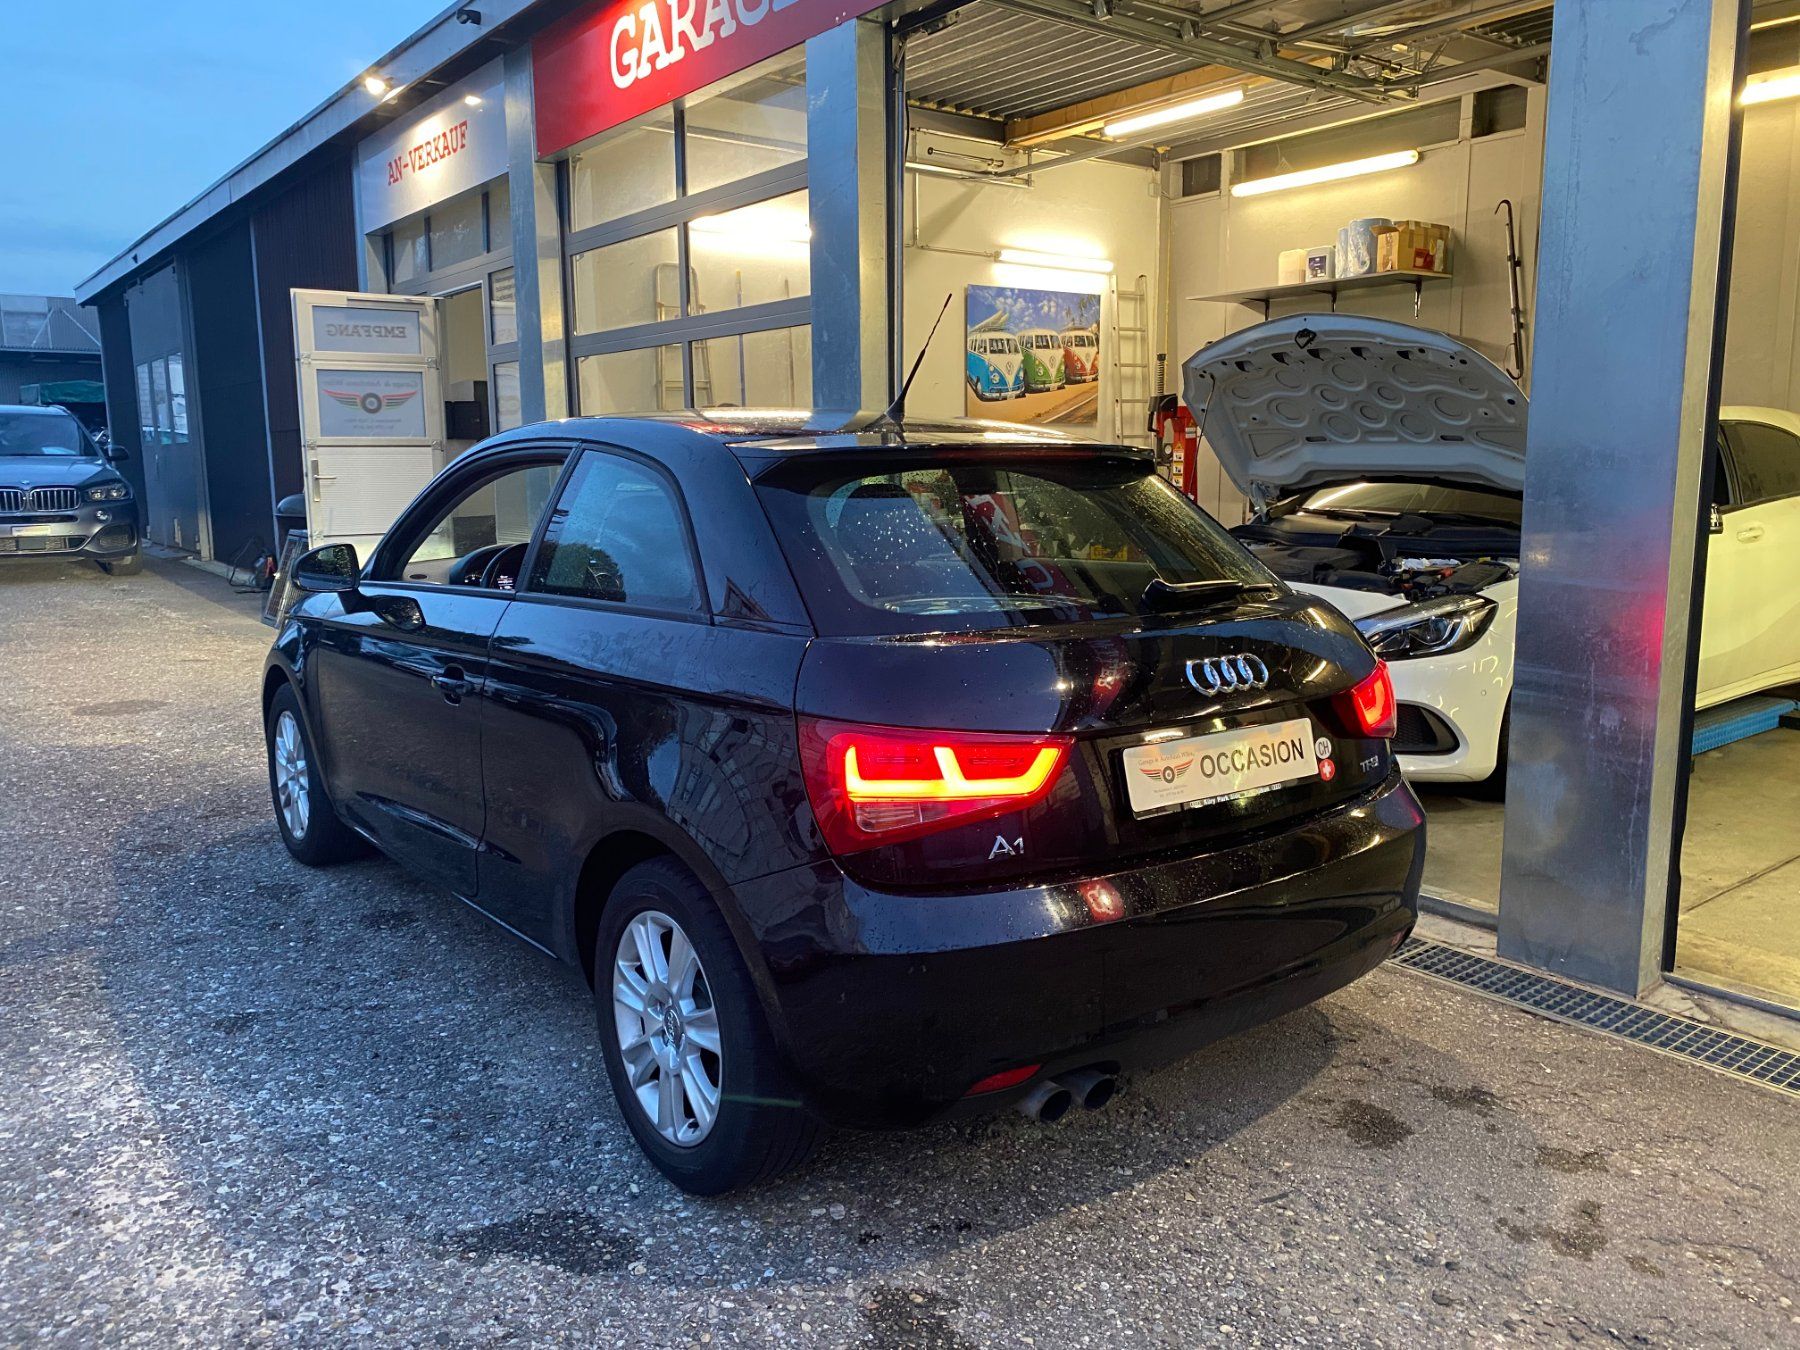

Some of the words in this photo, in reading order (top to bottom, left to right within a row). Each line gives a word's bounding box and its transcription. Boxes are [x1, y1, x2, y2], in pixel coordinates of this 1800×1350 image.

[610, 0, 800, 89] GARA
[387, 120, 468, 186] AN-VERKAUF
[1200, 738, 1305, 779] OCCASION
[1318, 740, 1330, 756] CH
[988, 835, 1025, 860] A1
